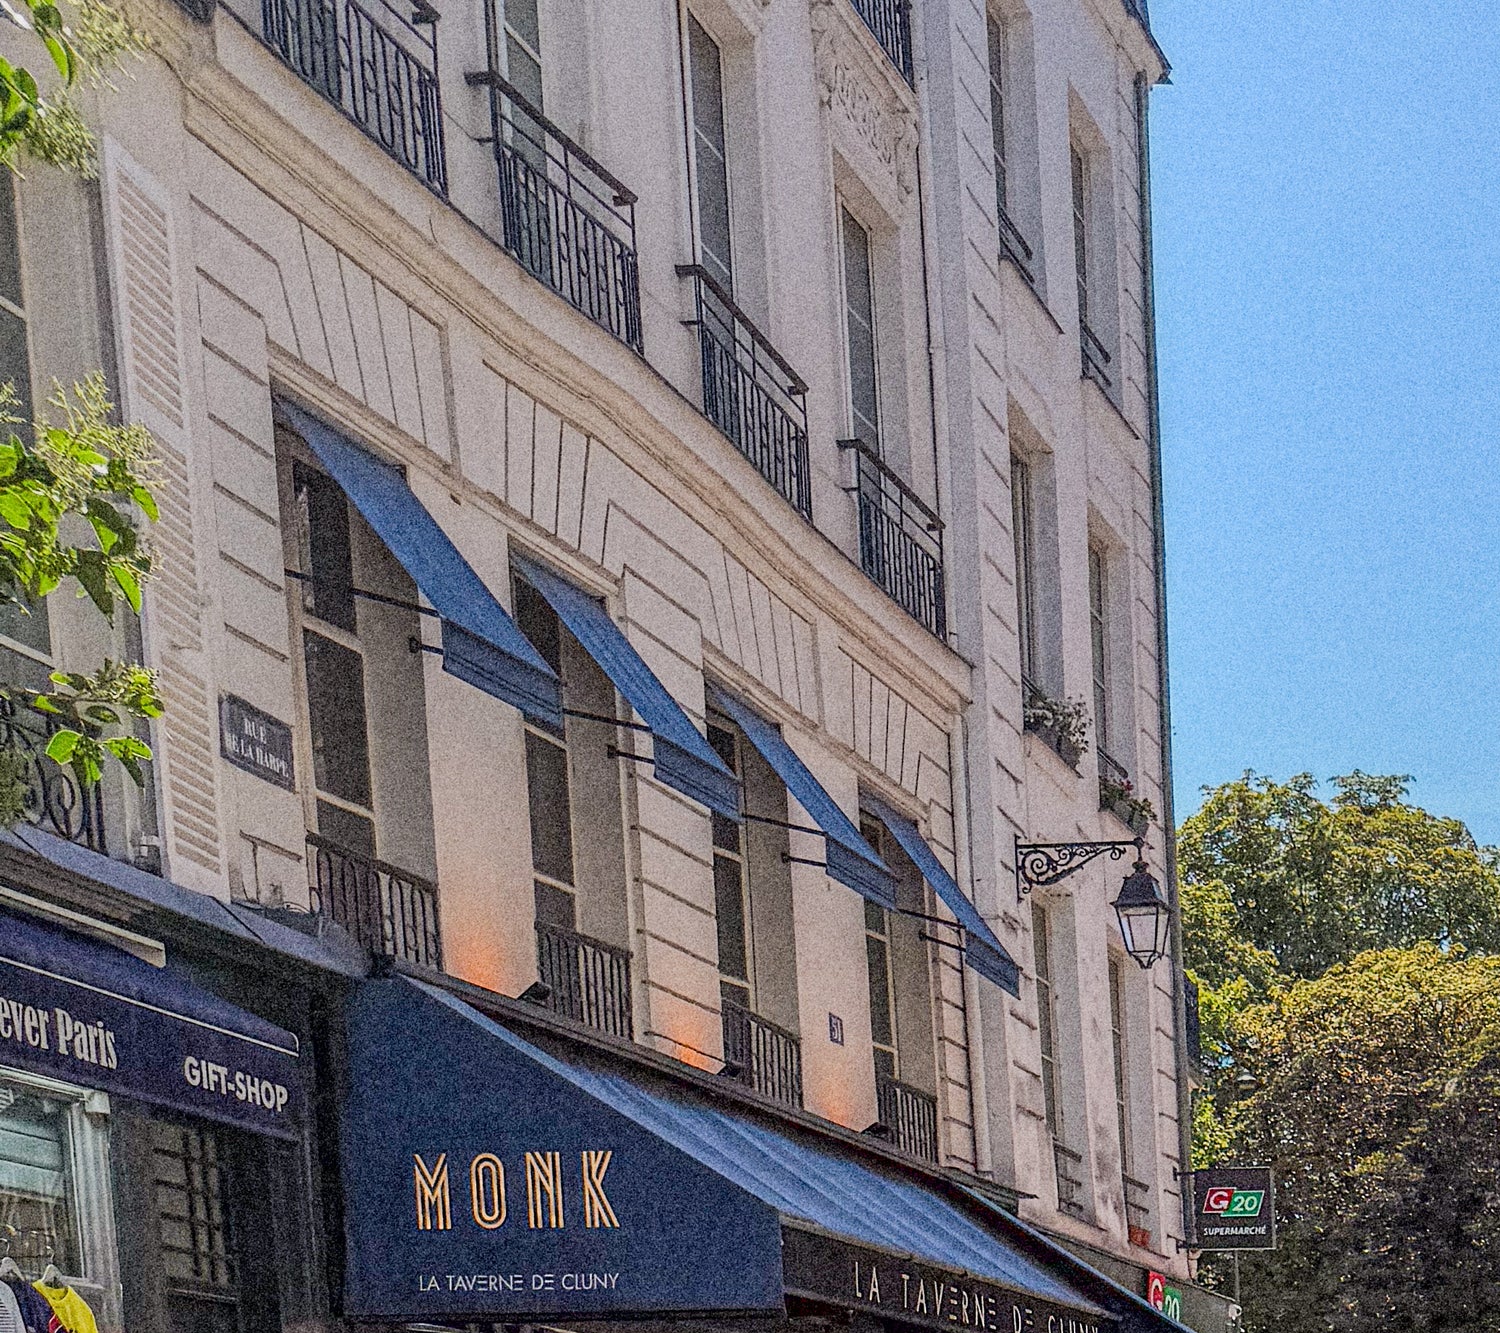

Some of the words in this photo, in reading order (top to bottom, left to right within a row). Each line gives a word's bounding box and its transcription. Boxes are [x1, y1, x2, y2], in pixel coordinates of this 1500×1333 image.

[244, 718, 267, 744] RUE
[55, 1008, 118, 1070] Paris
[183, 1056, 288, 1112] GIFT-SHOP
[413, 1151, 620, 1230] MONK
[1203, 1225, 1267, 1236] SUPERMARCHÉ
[419, 1275, 440, 1292] LA
[445, 1274, 523, 1291] TAVERNE
[532, 1273, 554, 1290] DE
[561, 1272, 620, 1290] CLUNY
[855, 1261, 881, 1303] LA
[901, 1273, 997, 1330] TAVERNE
